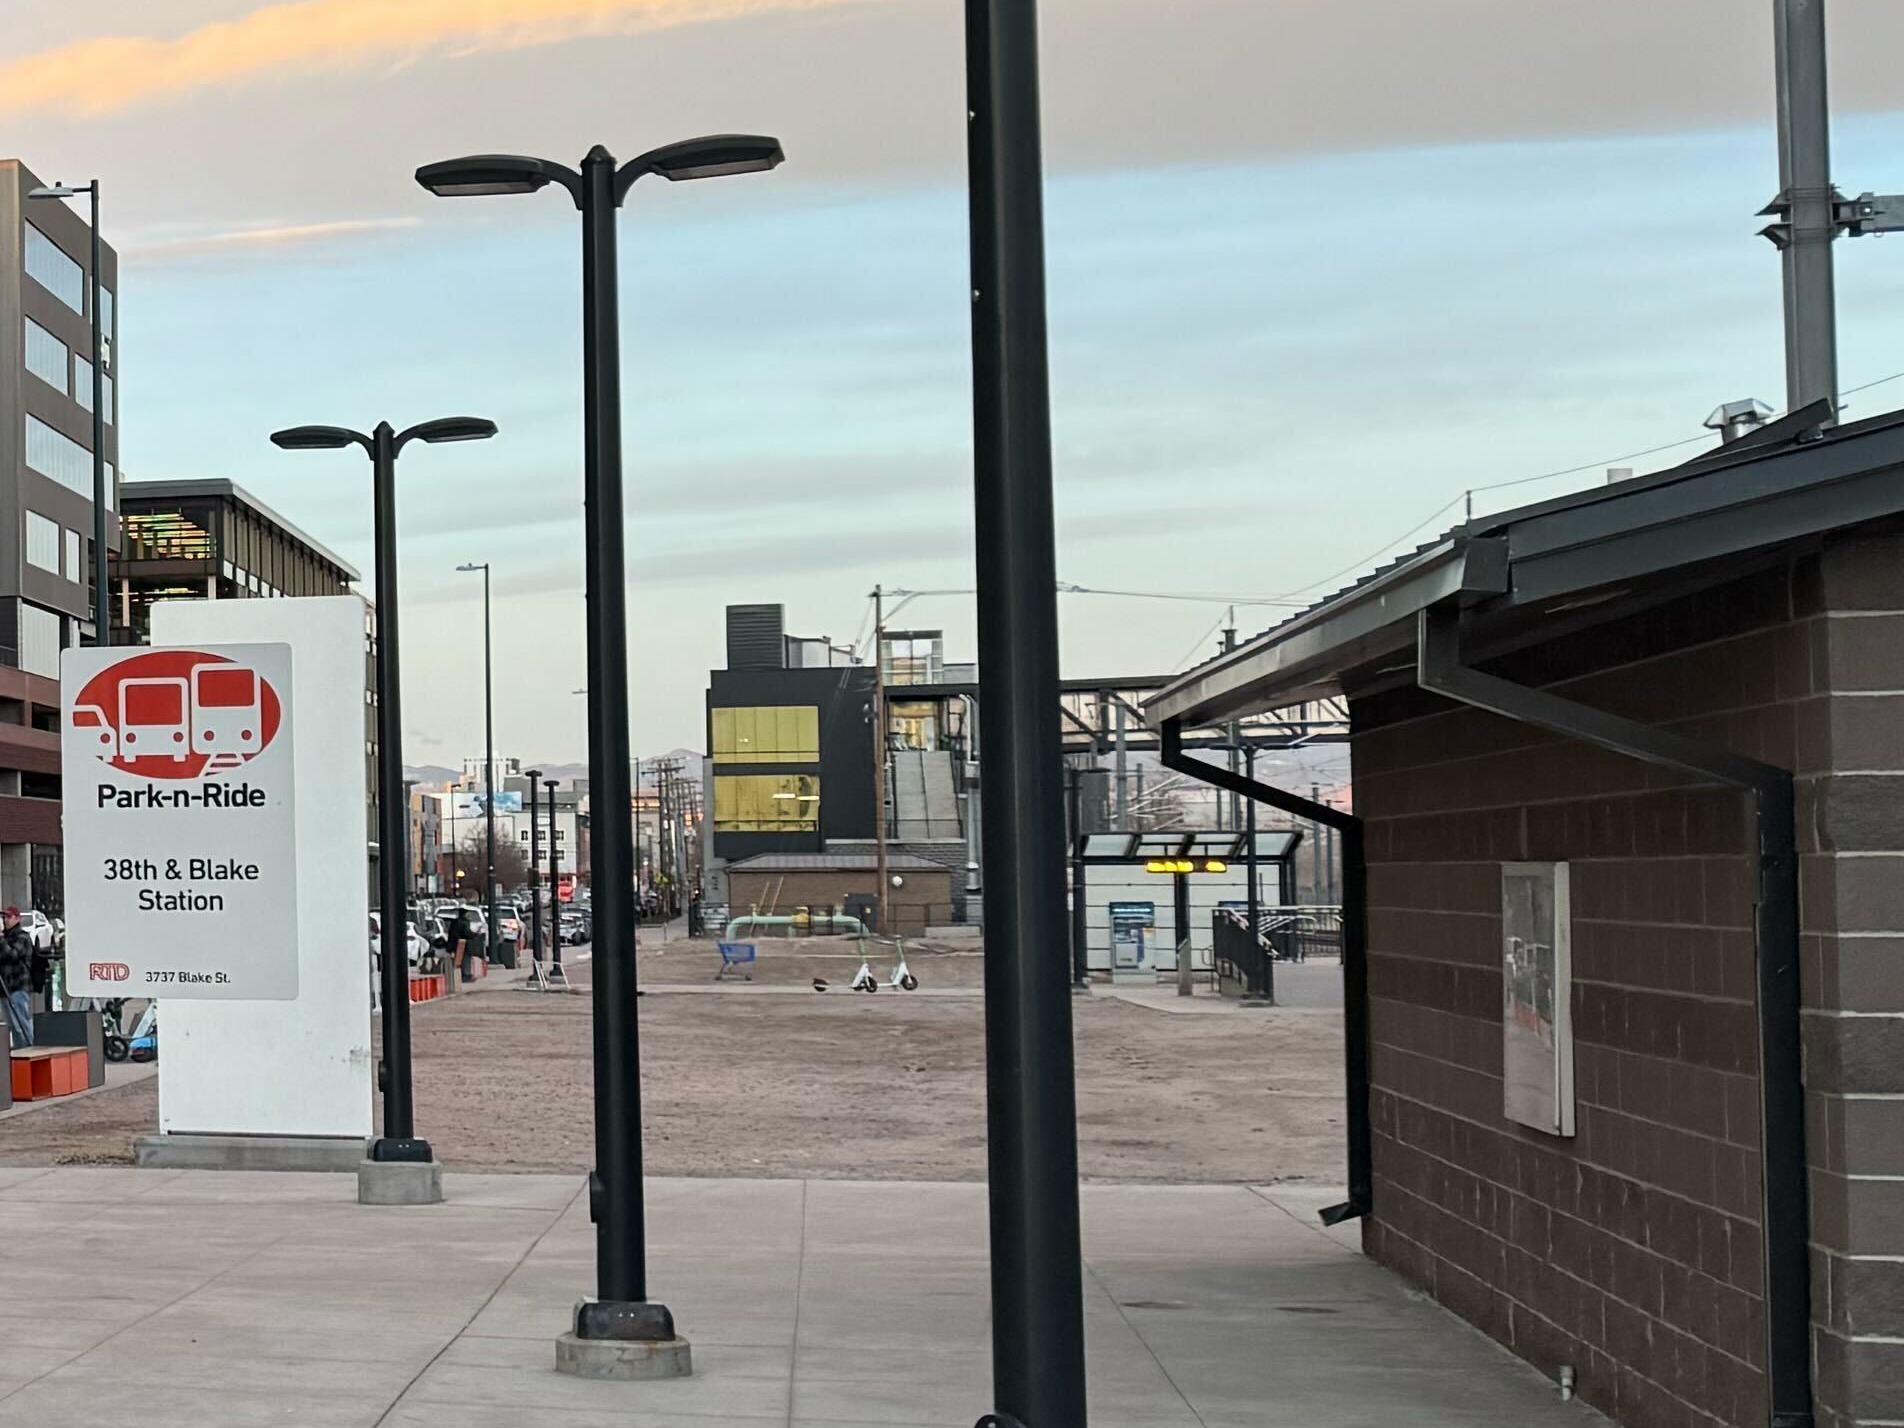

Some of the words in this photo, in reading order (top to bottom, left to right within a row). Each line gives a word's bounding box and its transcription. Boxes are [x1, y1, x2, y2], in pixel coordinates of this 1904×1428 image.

[97, 782, 267, 808] Park-n-Ride
[103, 858, 158, 881] 38th
[165, 858, 183, 881] &
[189, 858, 260, 881] Blake
[138, 888, 224, 911] Station
[89, 962, 130, 982] RTD
[145, 972, 176, 984] 3737
[178, 971, 213, 984] Blake
[214, 971, 232, 984] St.
